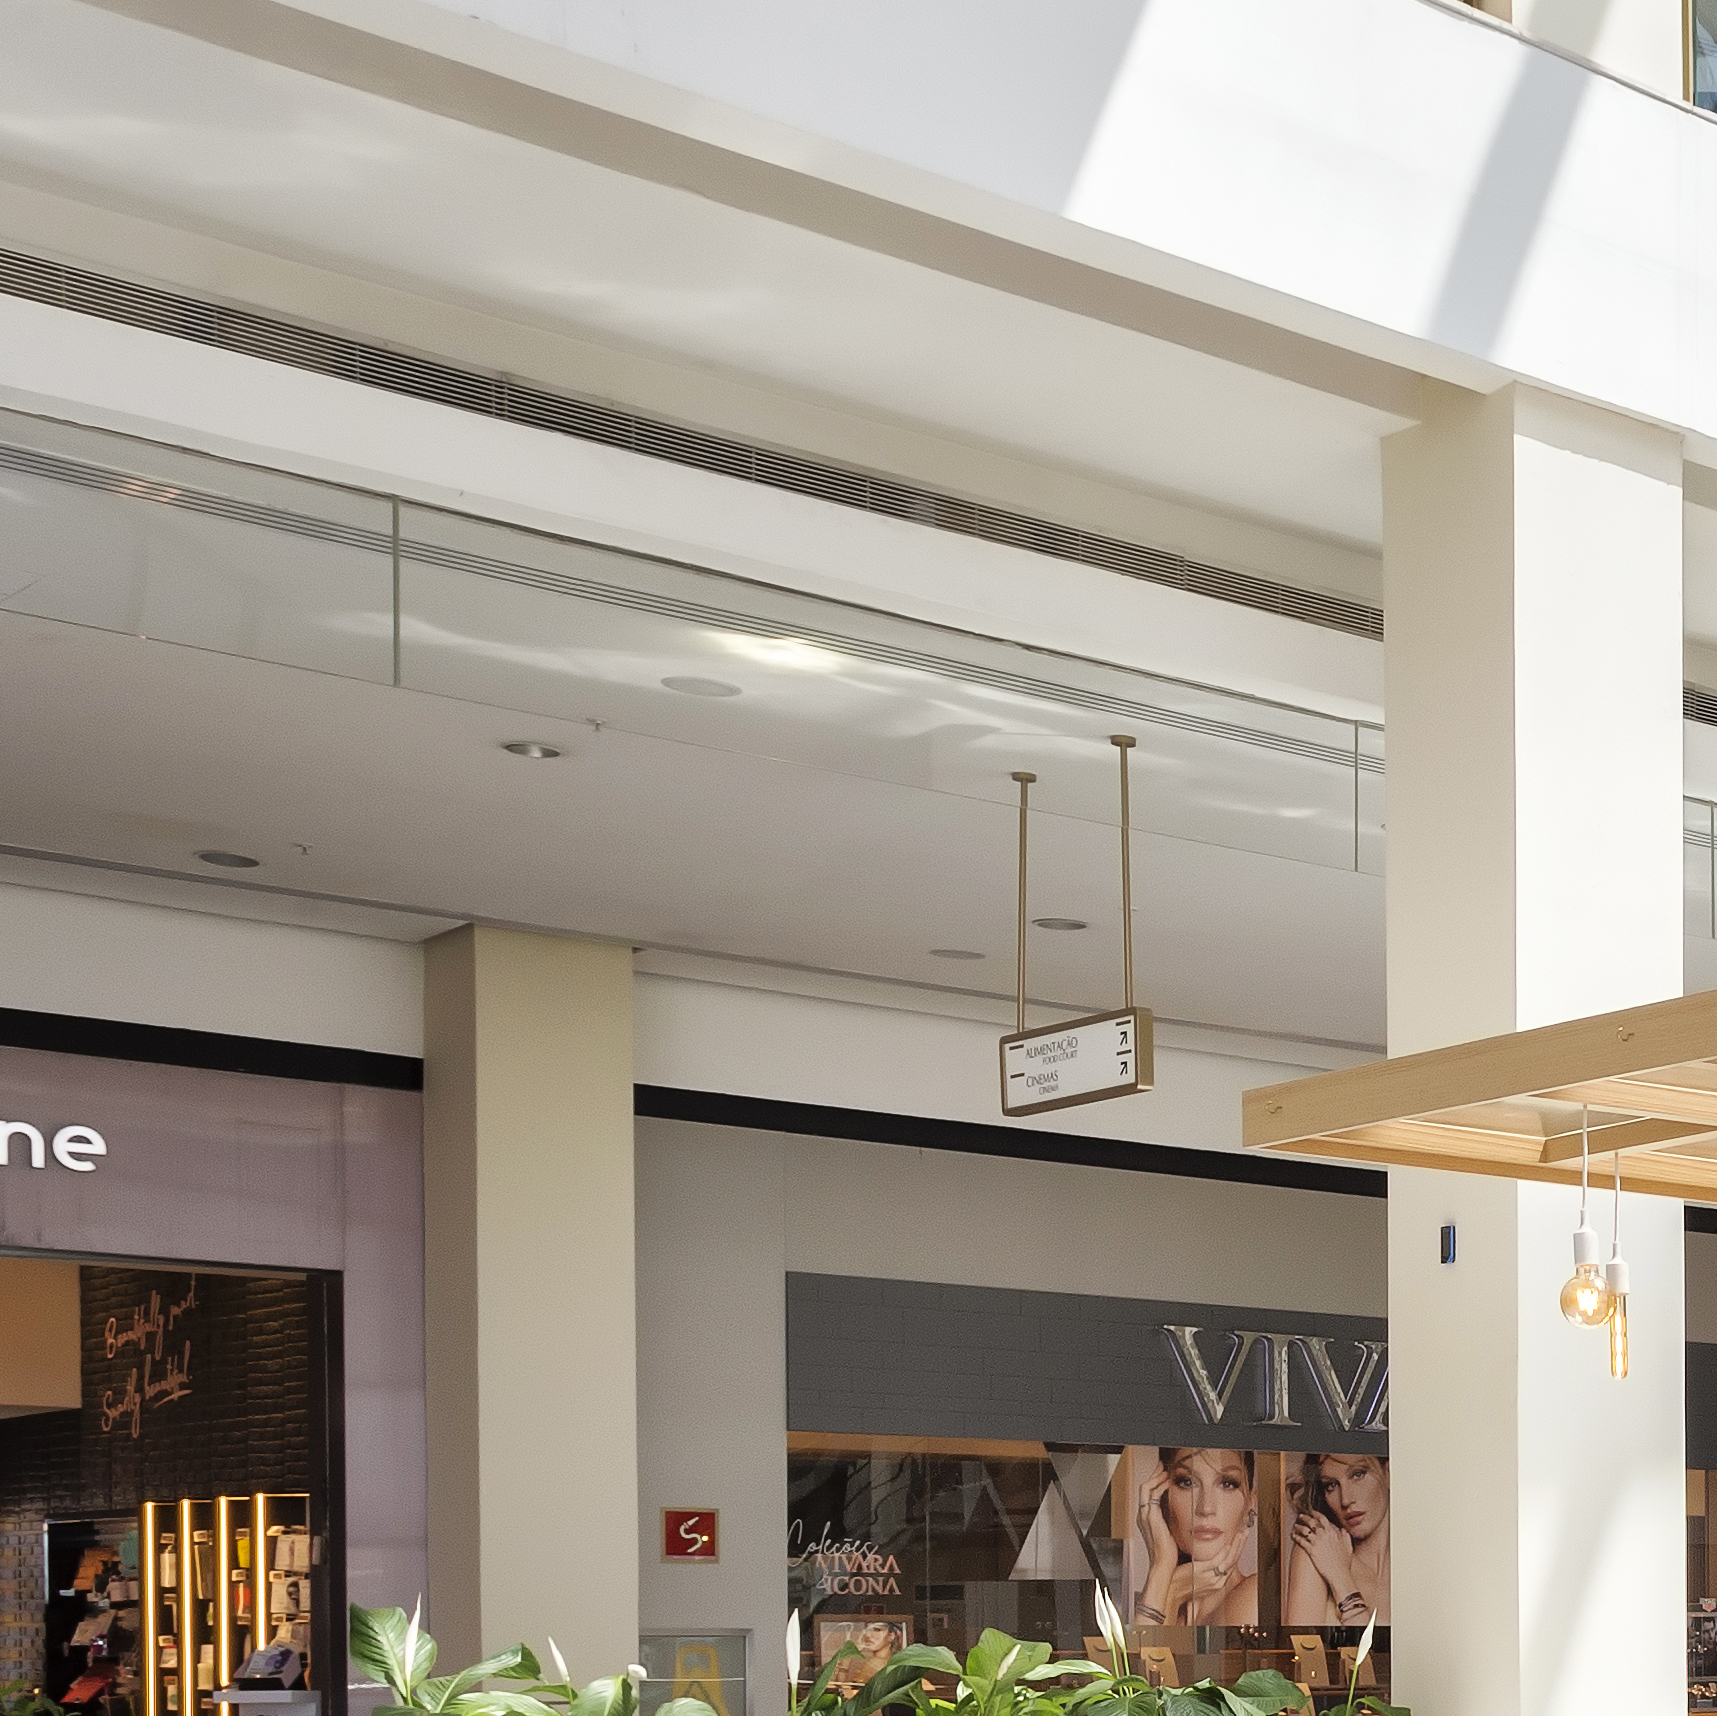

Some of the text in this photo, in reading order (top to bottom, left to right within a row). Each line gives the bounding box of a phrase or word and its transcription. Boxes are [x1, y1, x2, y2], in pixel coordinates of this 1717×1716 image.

[1025, 1036, 1078, 1059] ALIMENTAÇÃO
[1026, 1070, 1059, 1088] CINEMAS
[0, 1120, 107, 1172] ne
[787, 1518, 879, 1568] Coleções
[815, 1553, 902, 1574] VIVARA
[824, 1575, 902, 1595] ICONA
